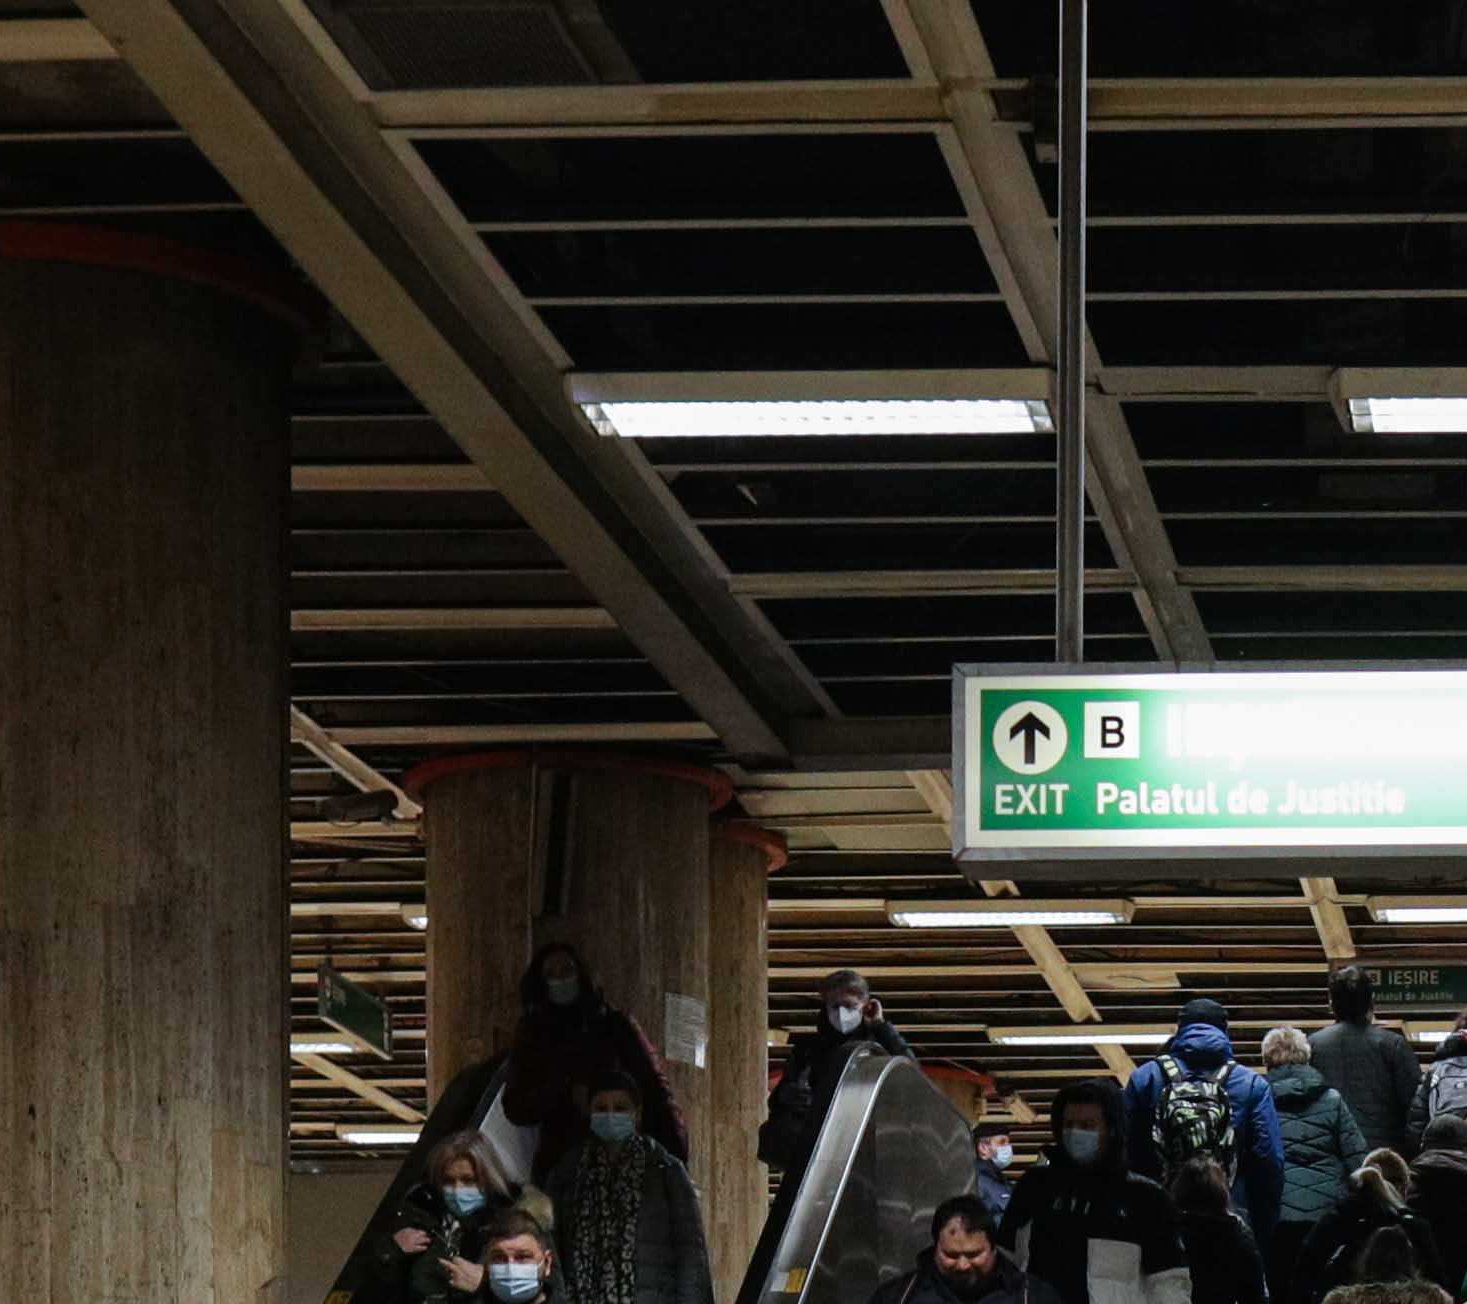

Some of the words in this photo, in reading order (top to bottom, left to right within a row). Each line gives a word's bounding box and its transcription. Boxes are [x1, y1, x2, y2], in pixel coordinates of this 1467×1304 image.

[1100, 715, 1125, 749] B
[994, 783, 1070, 815] EXIT
[1096, 780, 1219, 815] Palatul
[1227, 781, 1270, 815] de
[1277, 780, 1406, 815] Justitie
